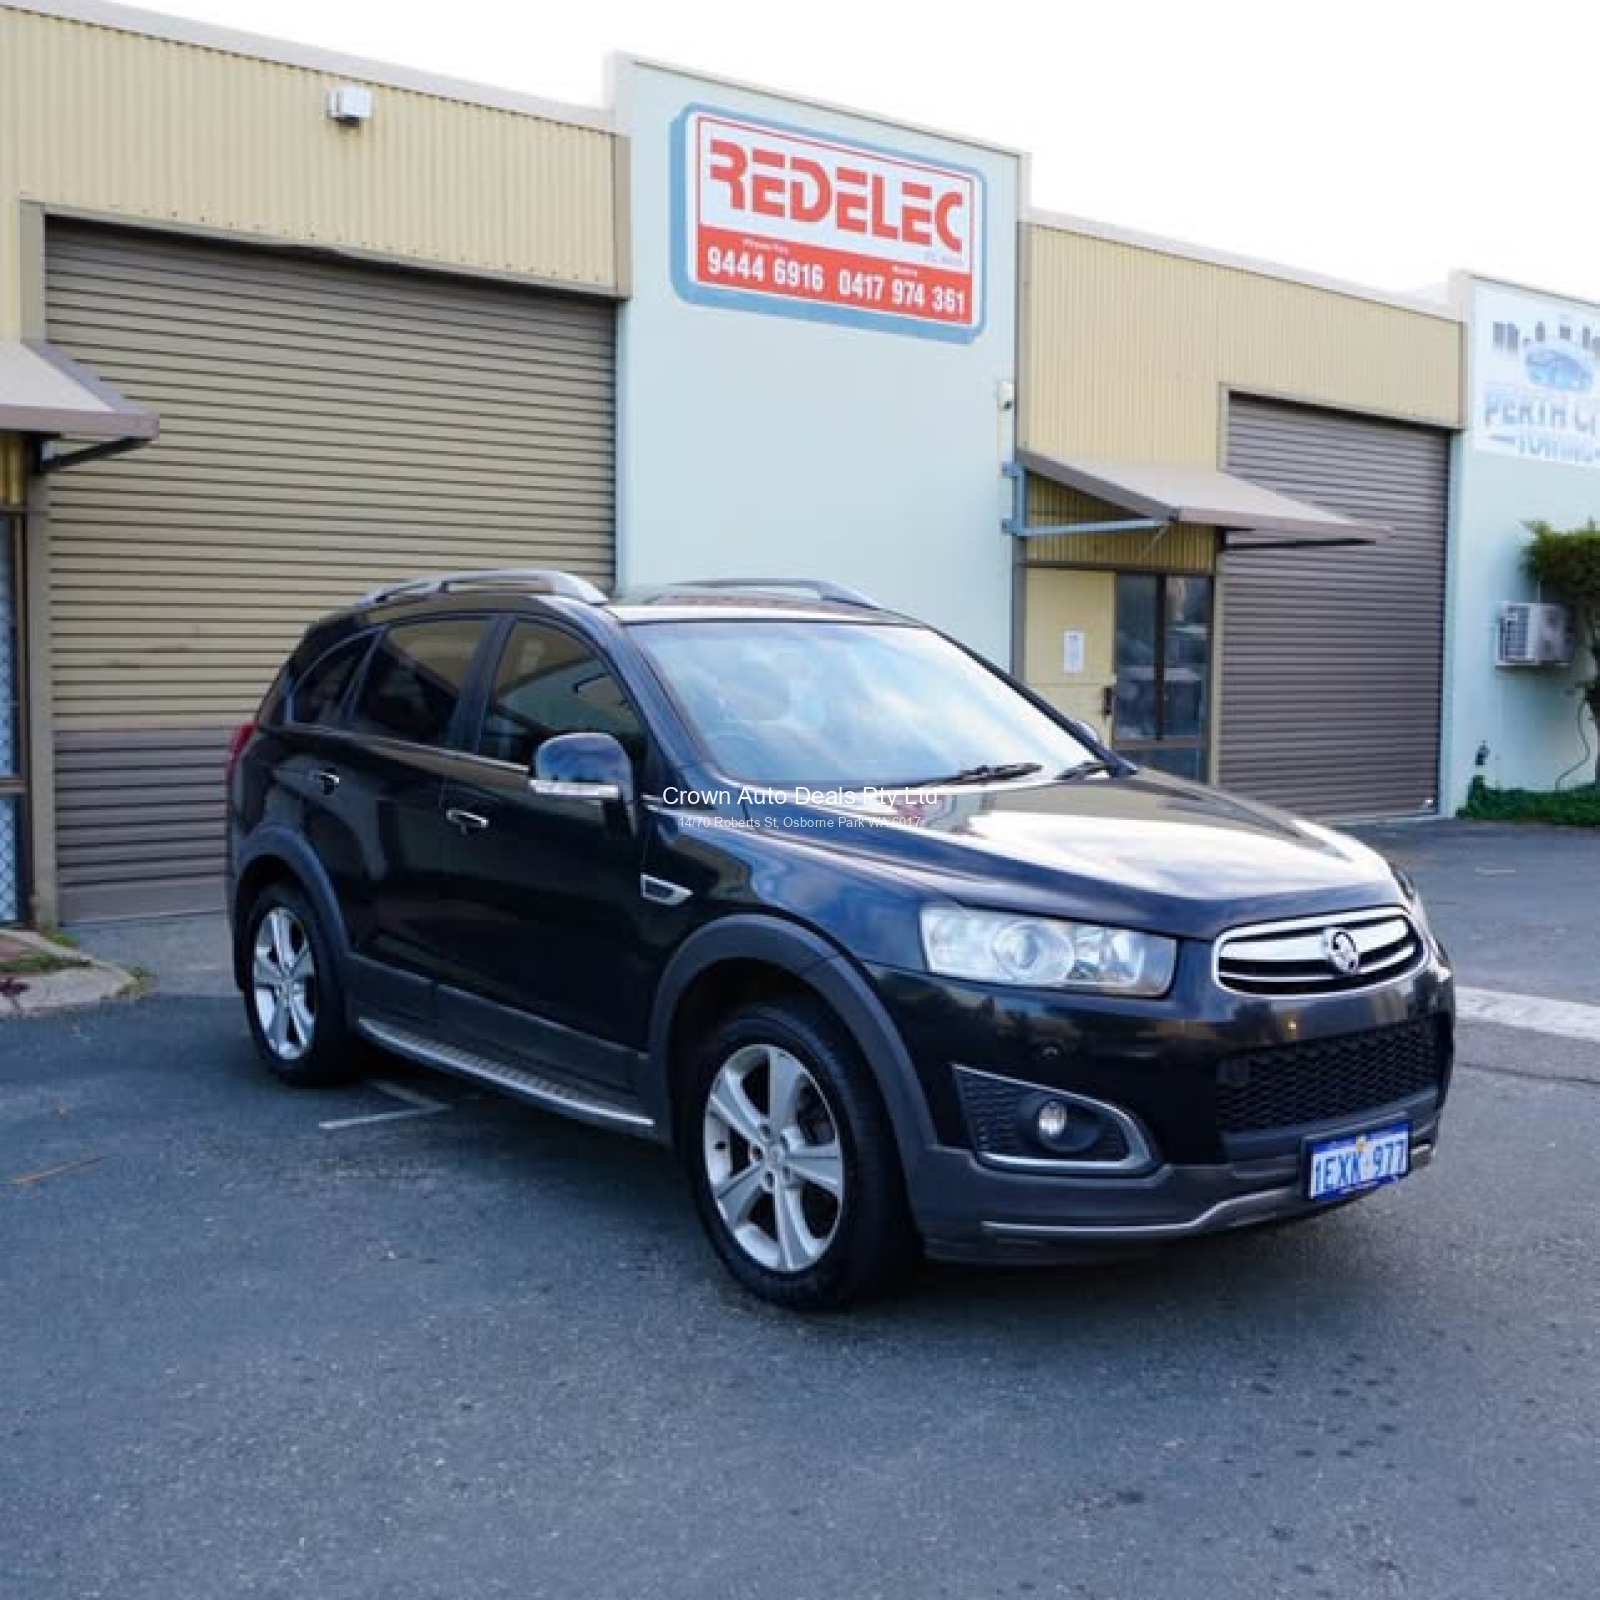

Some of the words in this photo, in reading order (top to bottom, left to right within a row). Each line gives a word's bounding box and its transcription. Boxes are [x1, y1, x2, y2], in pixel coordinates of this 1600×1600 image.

[710, 138, 963, 252] REDELEC
[708, 246, 764, 281] 9444
[773, 258, 824, 291] 6916
[839, 269, 884, 300] 0417
[892, 278, 925, 307] 974
